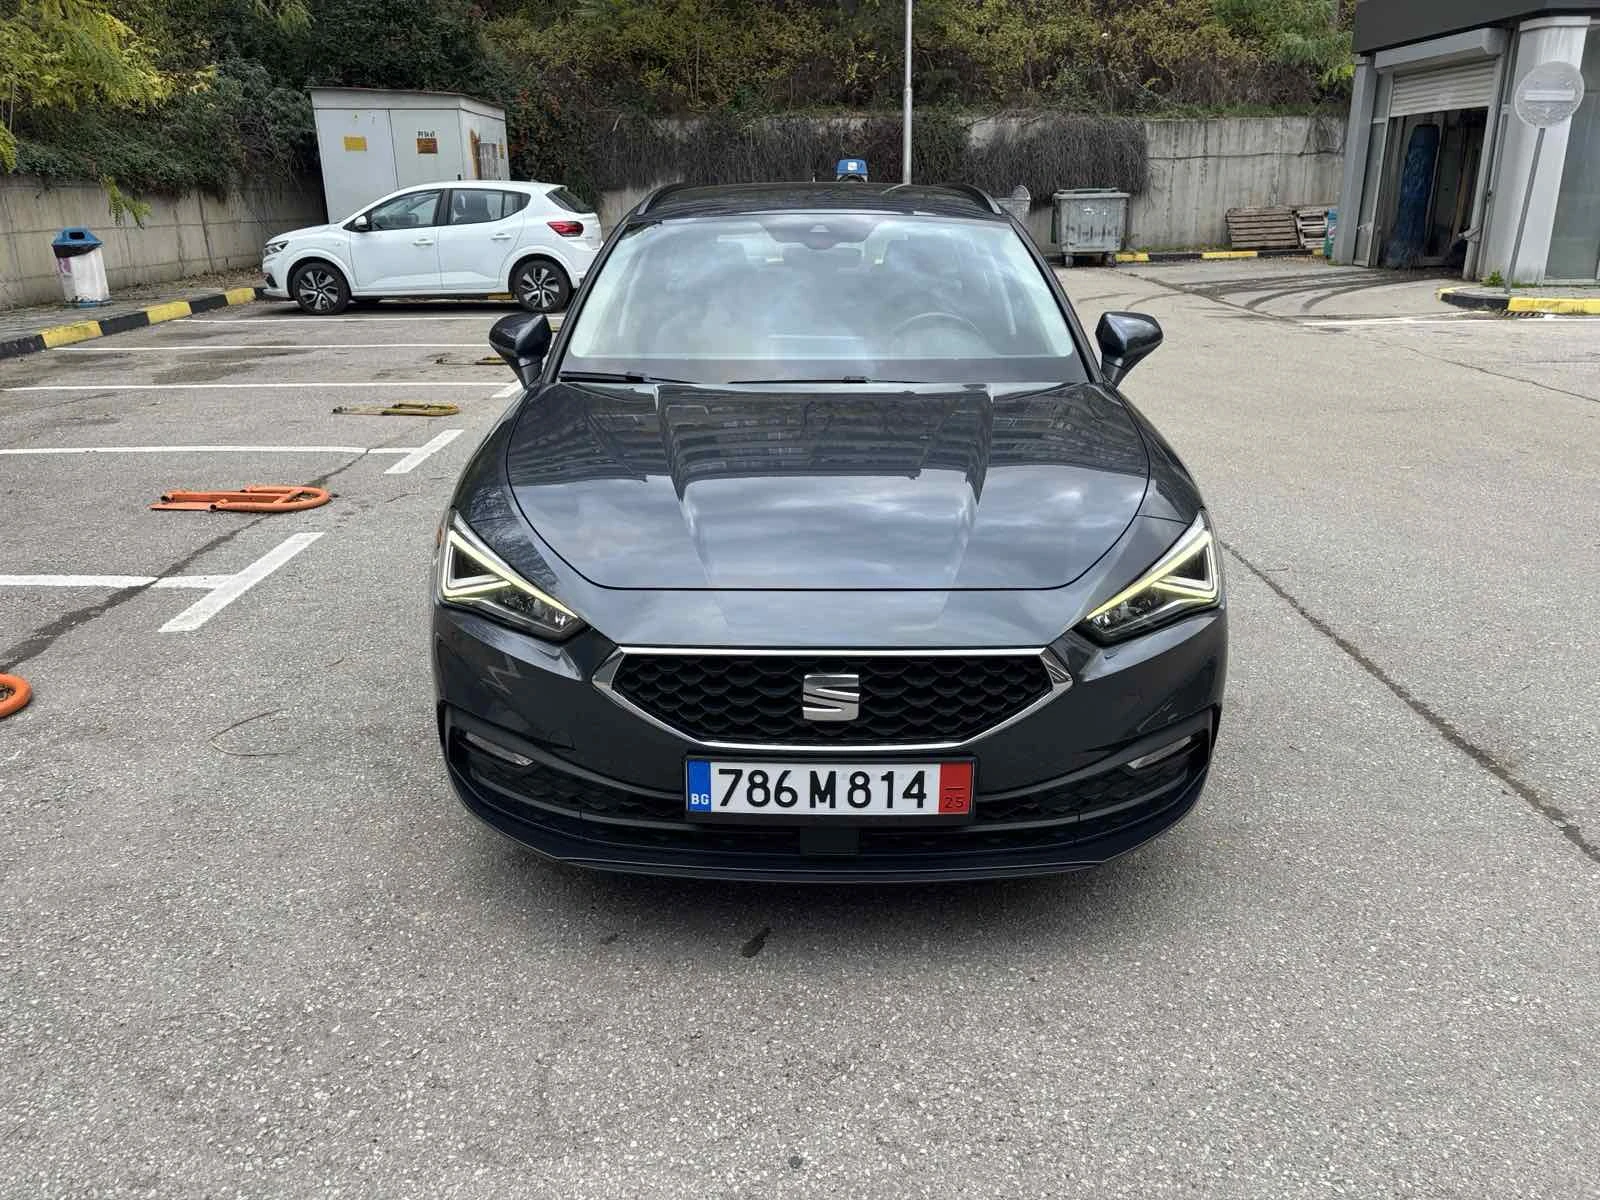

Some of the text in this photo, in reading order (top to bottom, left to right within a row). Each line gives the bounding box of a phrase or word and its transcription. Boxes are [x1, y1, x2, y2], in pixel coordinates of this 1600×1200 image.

[718, 768, 927, 808] 786 M 814
[691, 793, 710, 805] BG
[944, 796, 964, 808] 25
